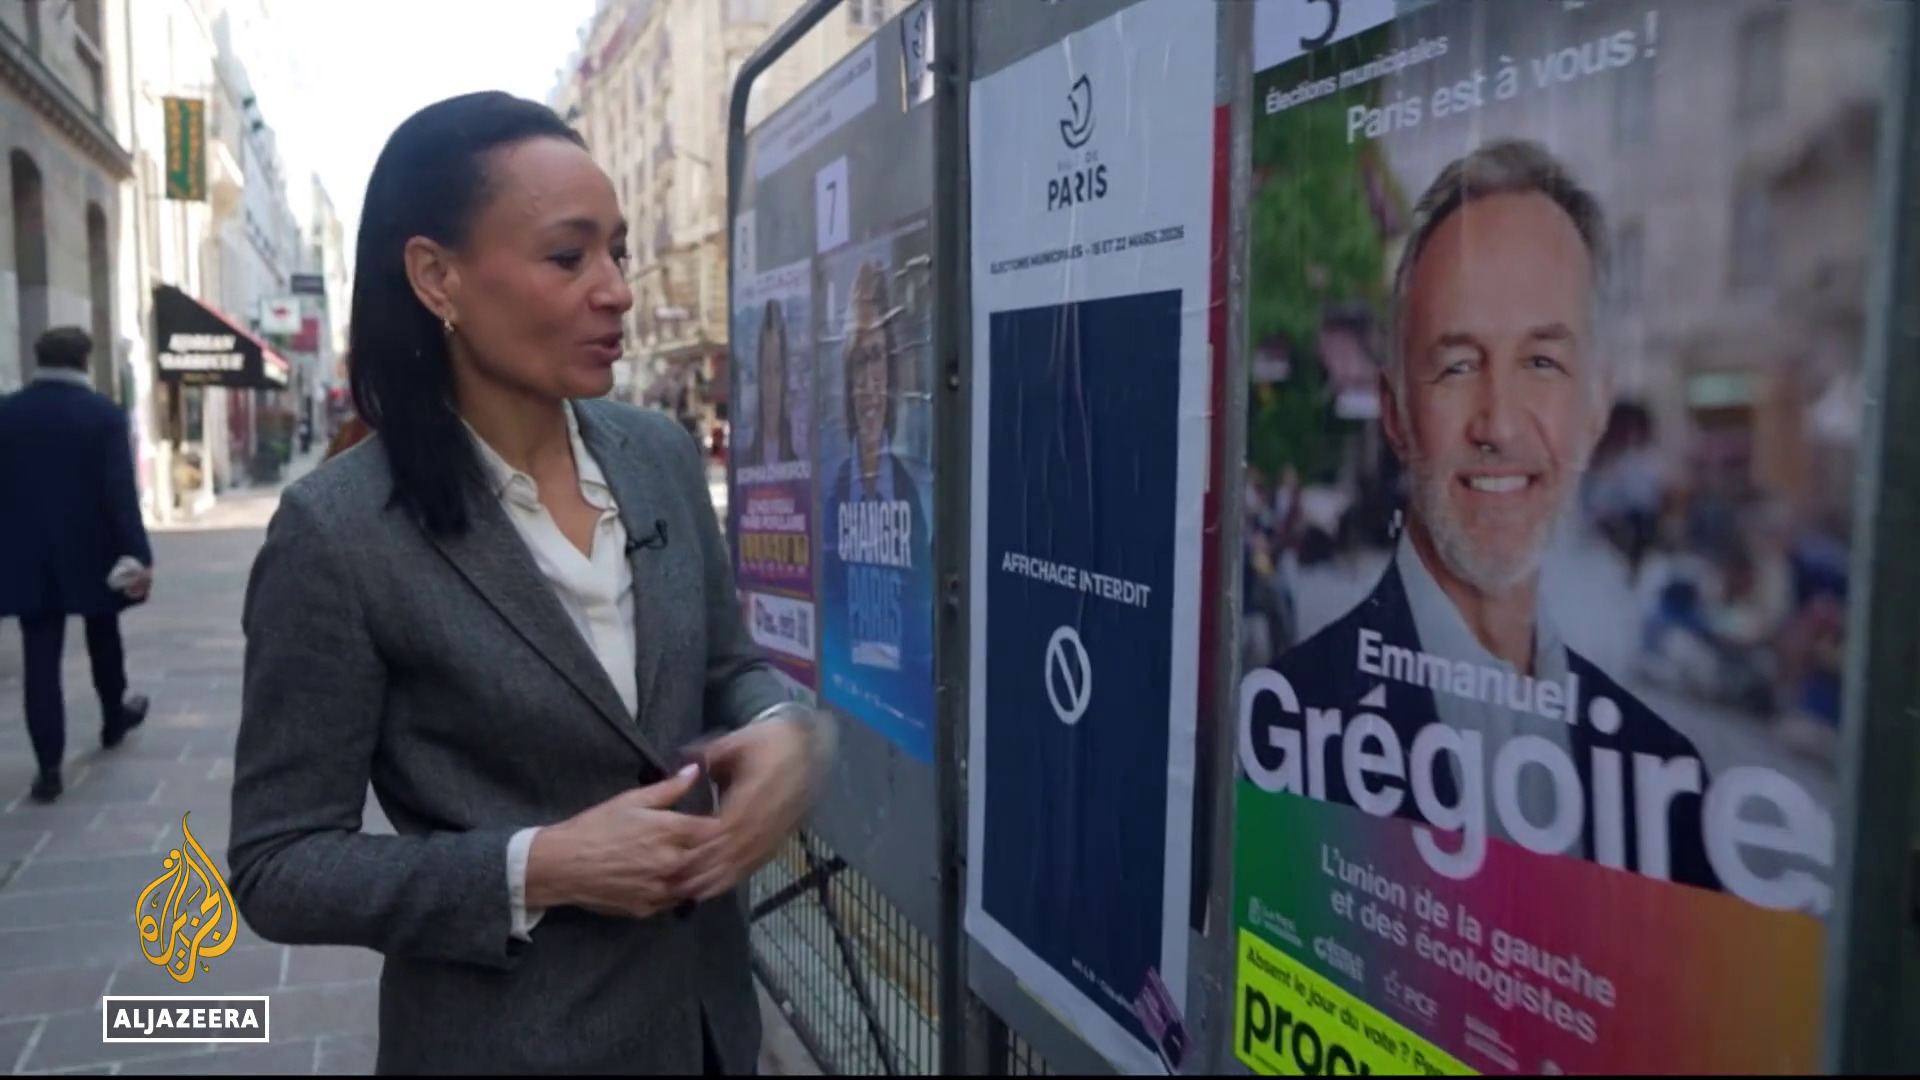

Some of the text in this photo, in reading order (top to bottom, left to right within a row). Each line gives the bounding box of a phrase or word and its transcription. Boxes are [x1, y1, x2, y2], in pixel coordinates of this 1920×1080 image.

[1266, 36, 1449, 114] Élections municipales
[1347, 9, 1658, 144] Paris est à vous !
[826, 180, 838, 237] 7
[1048, 163, 1108, 211] PARIS
[1128, 230, 1157, 248] MARS
[838, 500, 912, 568] CHANGER
[1002, 551, 1152, 608] AFFICHAGE INTERDIT
[1357, 628, 1580, 726] Emmanuel
[1237, 667, 1835, 913] Grégoire
[1321, 844, 1617, 1008] L'union de la gauche
[1330, 890, 1354, 920] et
[1360, 895, 1408, 948] des
[1415, 923, 1598, 1044] écologistes
[1243, 984, 1371, 1075] proc
[1246, 946, 1292, 988] Absent
[1294, 977, 1306, 997] le
[1306, 987, 1337, 1017] jour
[1340, 1008, 1360, 1032] du
[1363, 1023, 1398, 1056] vote
